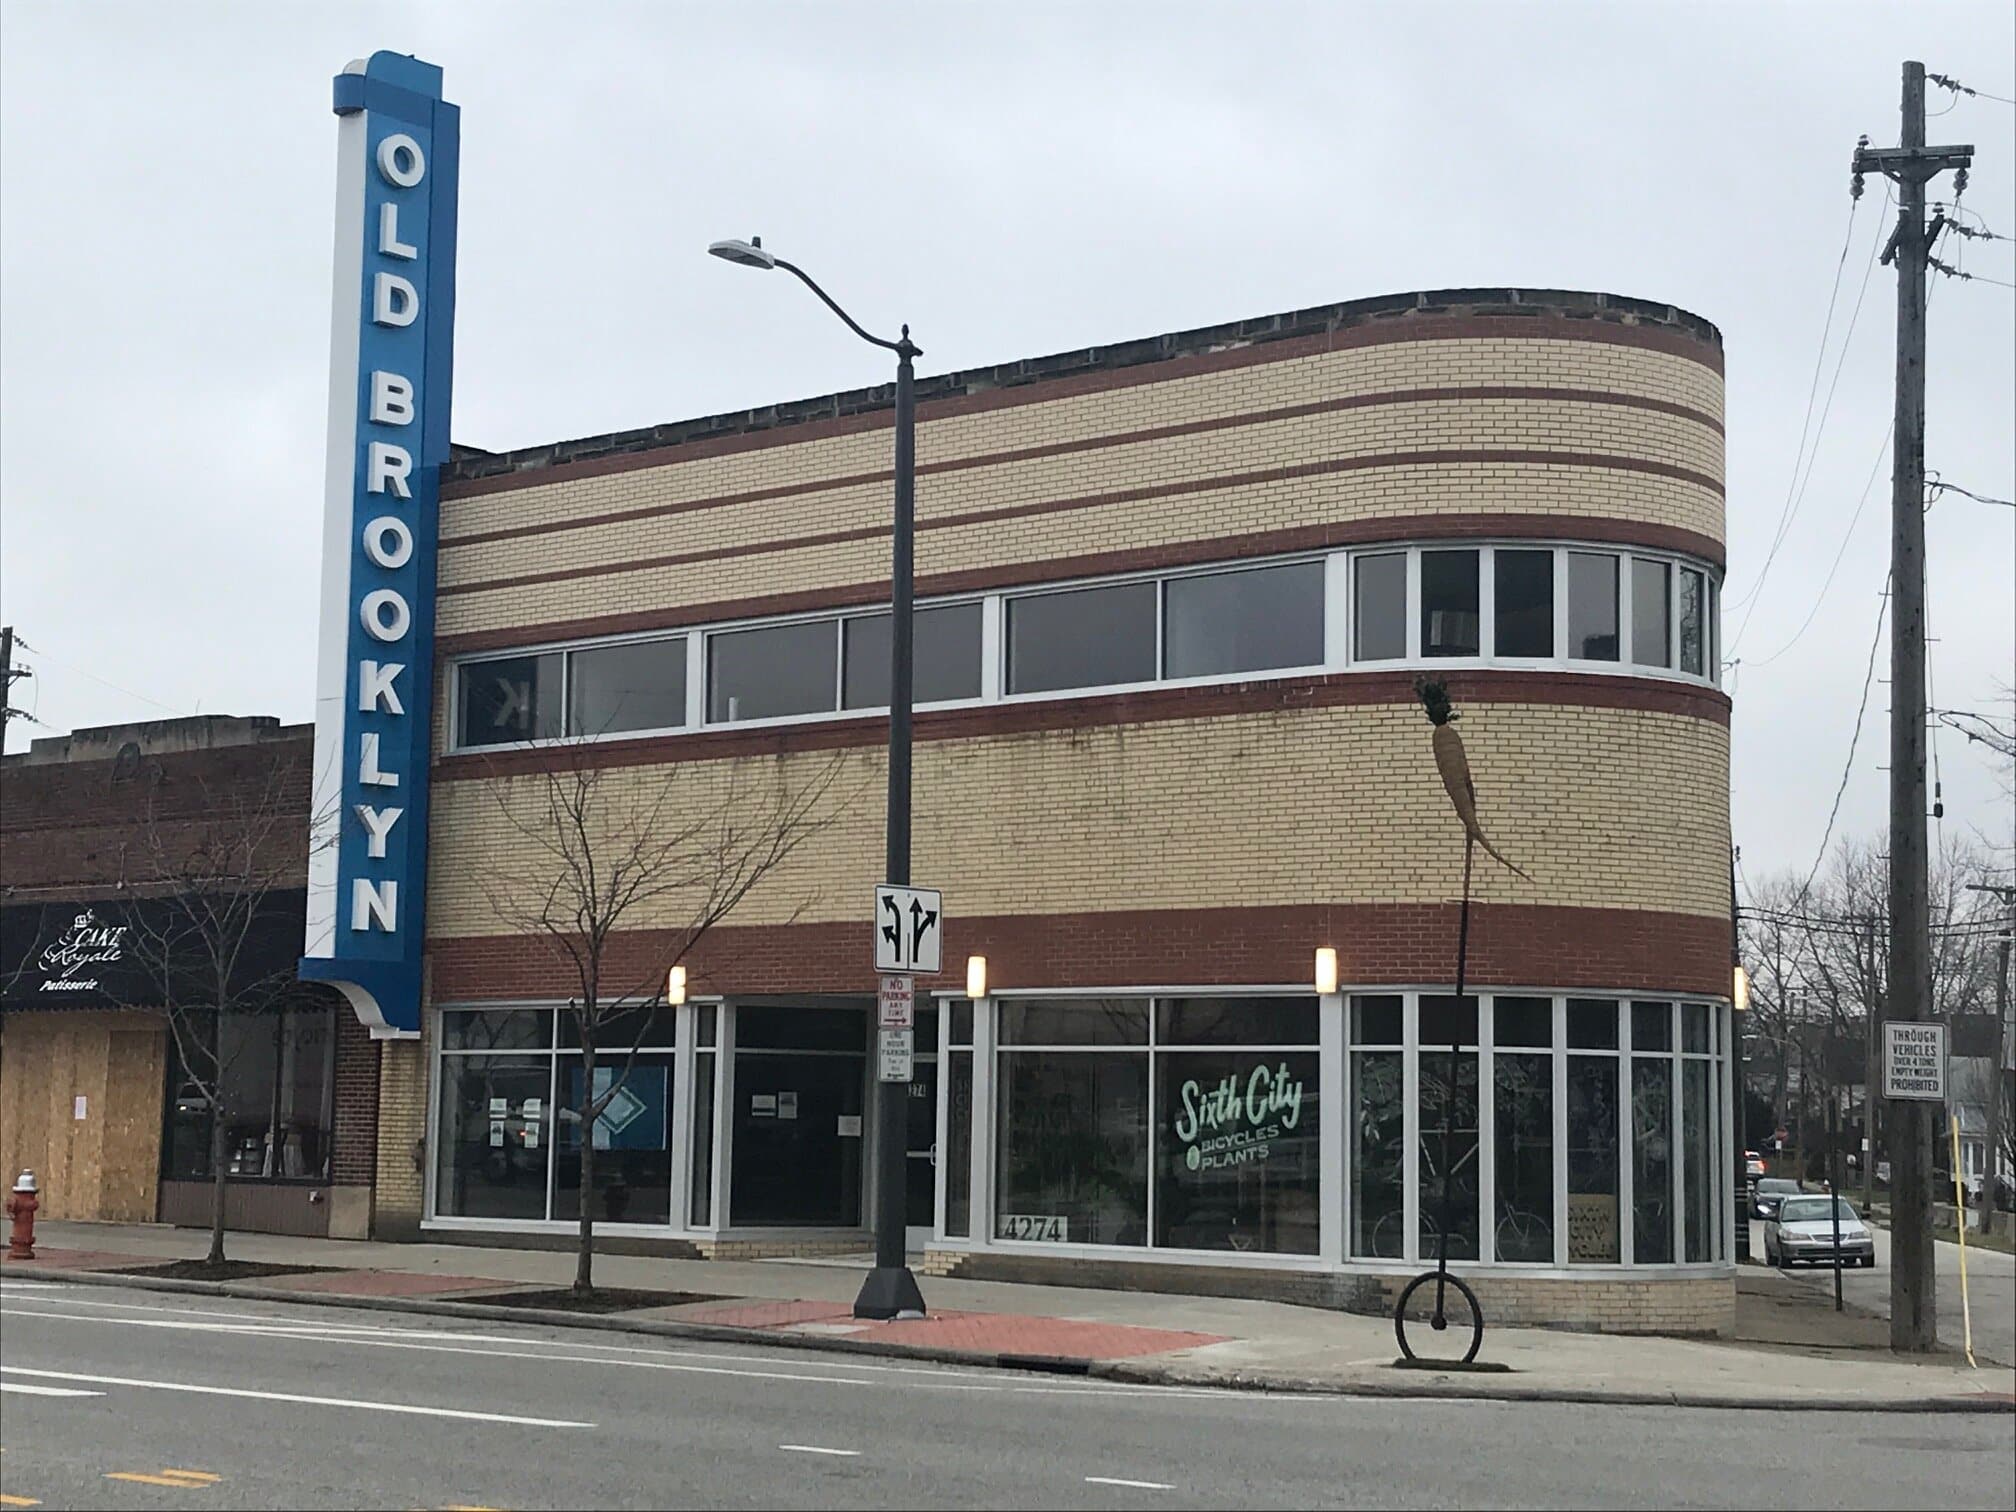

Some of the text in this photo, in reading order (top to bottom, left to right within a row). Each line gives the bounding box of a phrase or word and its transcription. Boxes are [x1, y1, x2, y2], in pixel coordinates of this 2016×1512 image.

[373, 133, 426, 328] OLD
[351, 370, 415, 933] BROOKLYN
[76, 926, 127, 947] CAKE
[50, 945, 122, 978] Royale
[39, 978, 98, 991] Patisserie
[889, 980, 903, 990] NO
[882, 992, 911, 1001] PARKING
[1893, 1029, 1936, 1043] THROUGH
[1893, 1044, 1936, 1056] VEHICLES
[1893, 1056, 1935, 1067] OVER 4 TONS
[1892, 1067, 1937, 1077] EMPTY WEIGHT
[1891, 1078, 1939, 1092] PROHIBITED
[1176, 1062, 1302, 1142] Sixth City
[1201, 1124, 1280, 1152] BICYCLES
[1201, 1144, 1269, 1170] PLANTS
[1004, 1216, 1062, 1241] 4274
